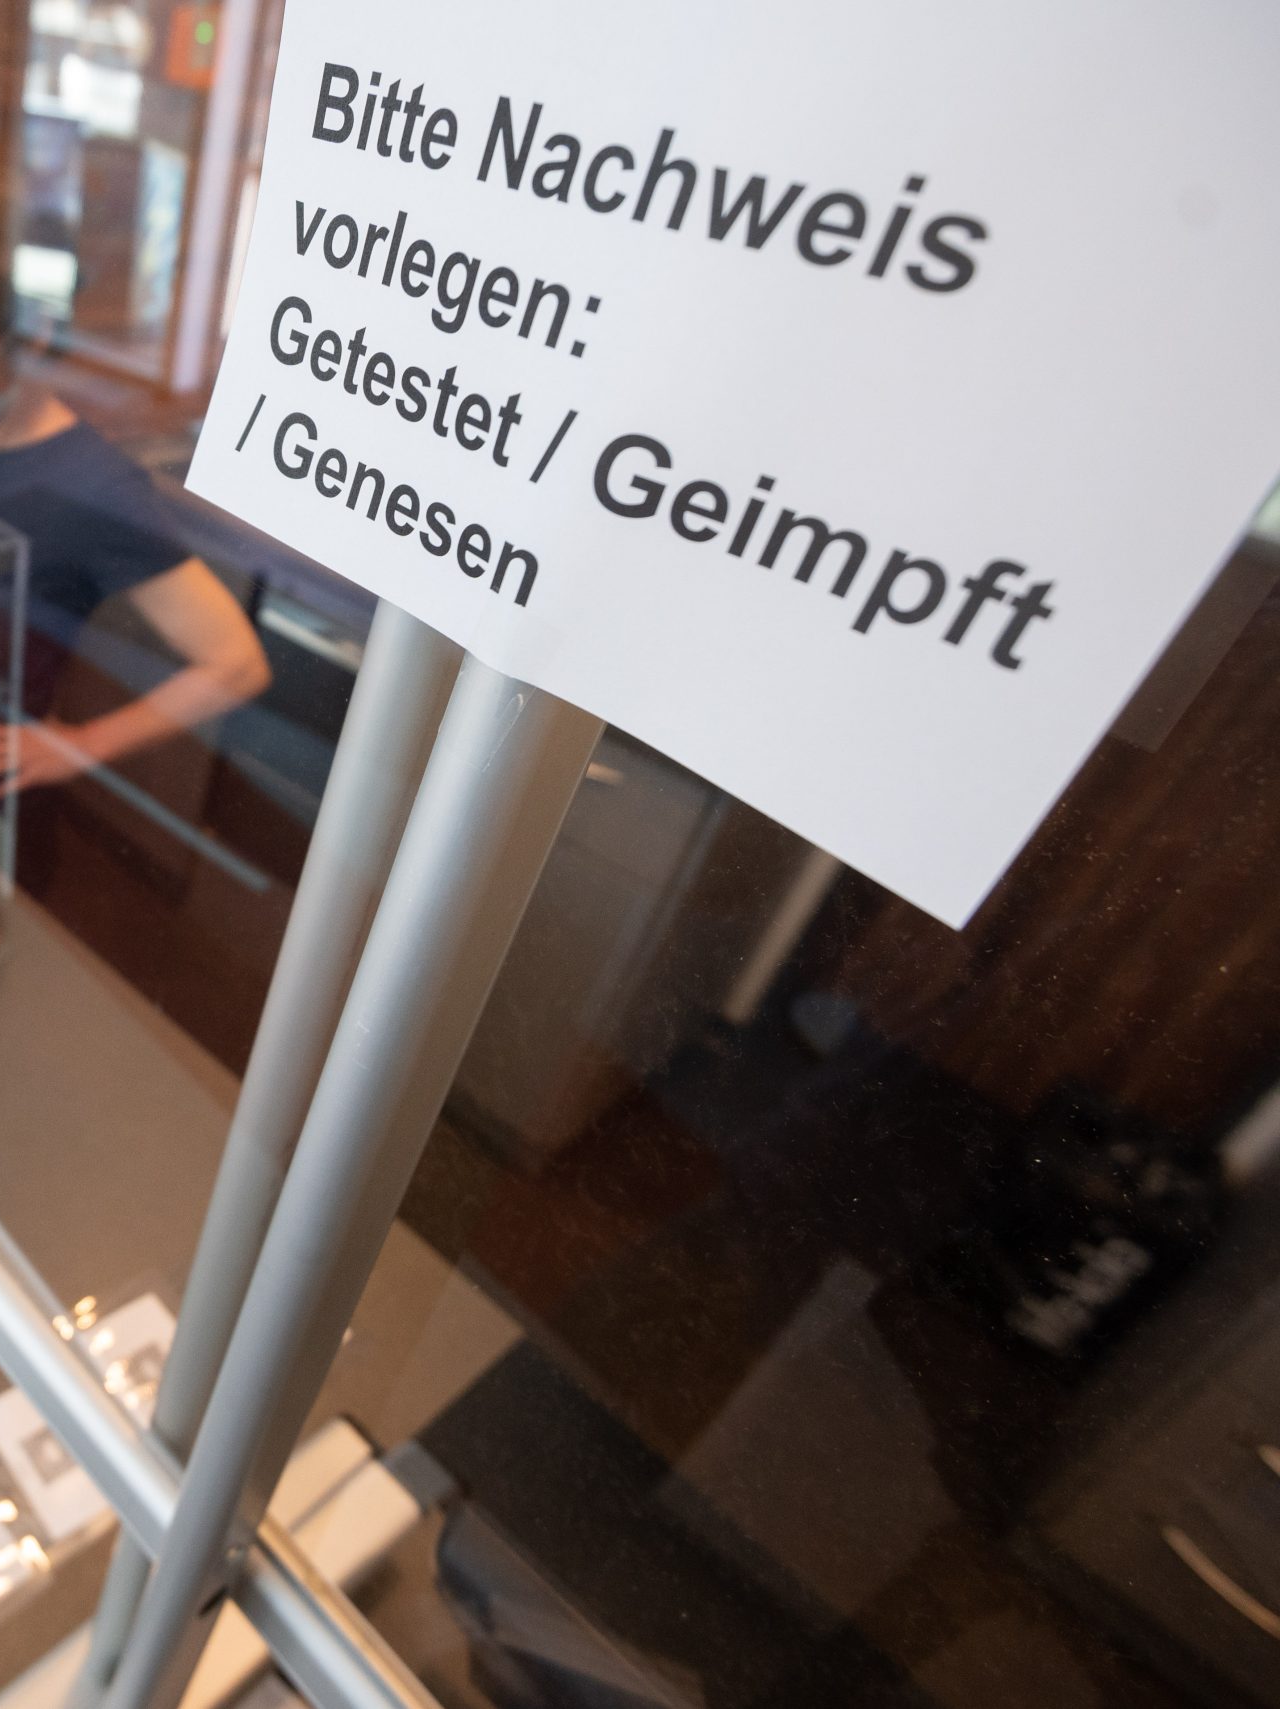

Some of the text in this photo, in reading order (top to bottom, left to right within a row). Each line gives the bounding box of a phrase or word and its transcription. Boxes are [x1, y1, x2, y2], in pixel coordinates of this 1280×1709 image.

[295, 200, 602, 358] vorlegen:
[311, 62, 990, 293] Bitte Nachweis
[235, 394, 539, 608] / Genesen
[270, 296, 1054, 670] Getestet / Geimpft
